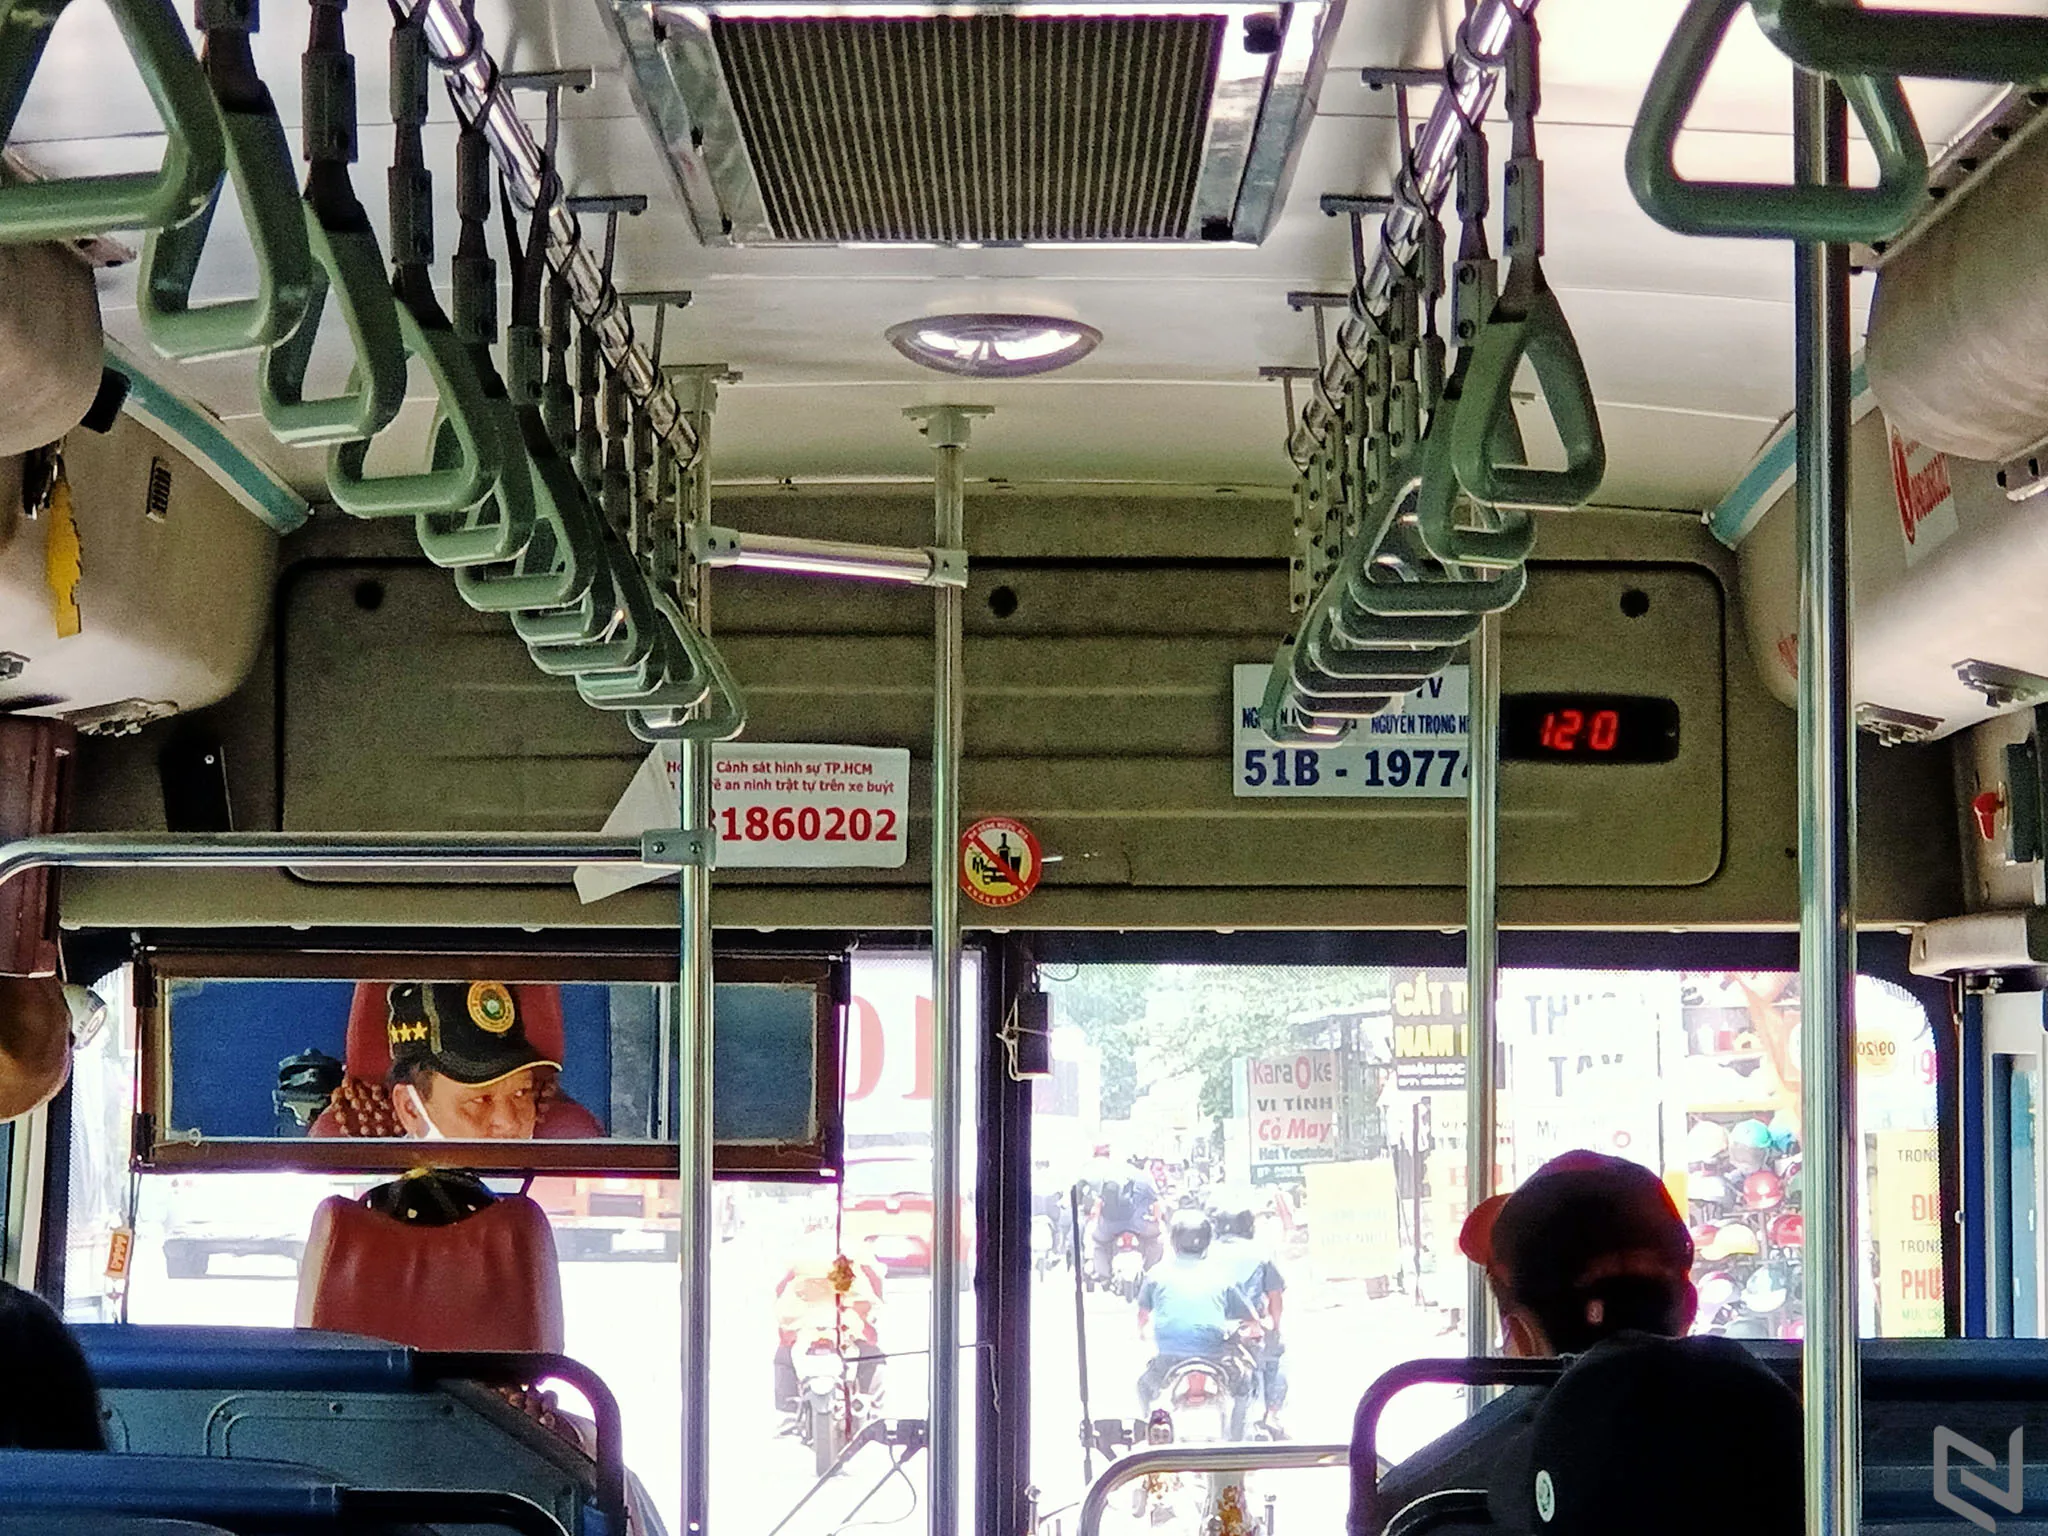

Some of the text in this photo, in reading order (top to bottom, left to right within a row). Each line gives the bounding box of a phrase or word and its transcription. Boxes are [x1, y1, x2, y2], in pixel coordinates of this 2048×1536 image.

[806, 762, 822, 776] sự
[824, 762, 873, 775] TP.HCM
[1244, 750, 1320, 786] 51B
[725, 780, 740, 790] an
[744, 778, 772, 791] ninh
[775, 779, 799, 793] trật
[802, 780, 816, 795] tự
[820, 779, 845, 792] trên
[848, 782, 864, 792] xe
[867, 780, 895, 796] buýt
[1395, 1024, 1454, 1057] NAM
[1257, 1098, 1277, 1112] VI
[1286, 1118, 1332, 1143] May
